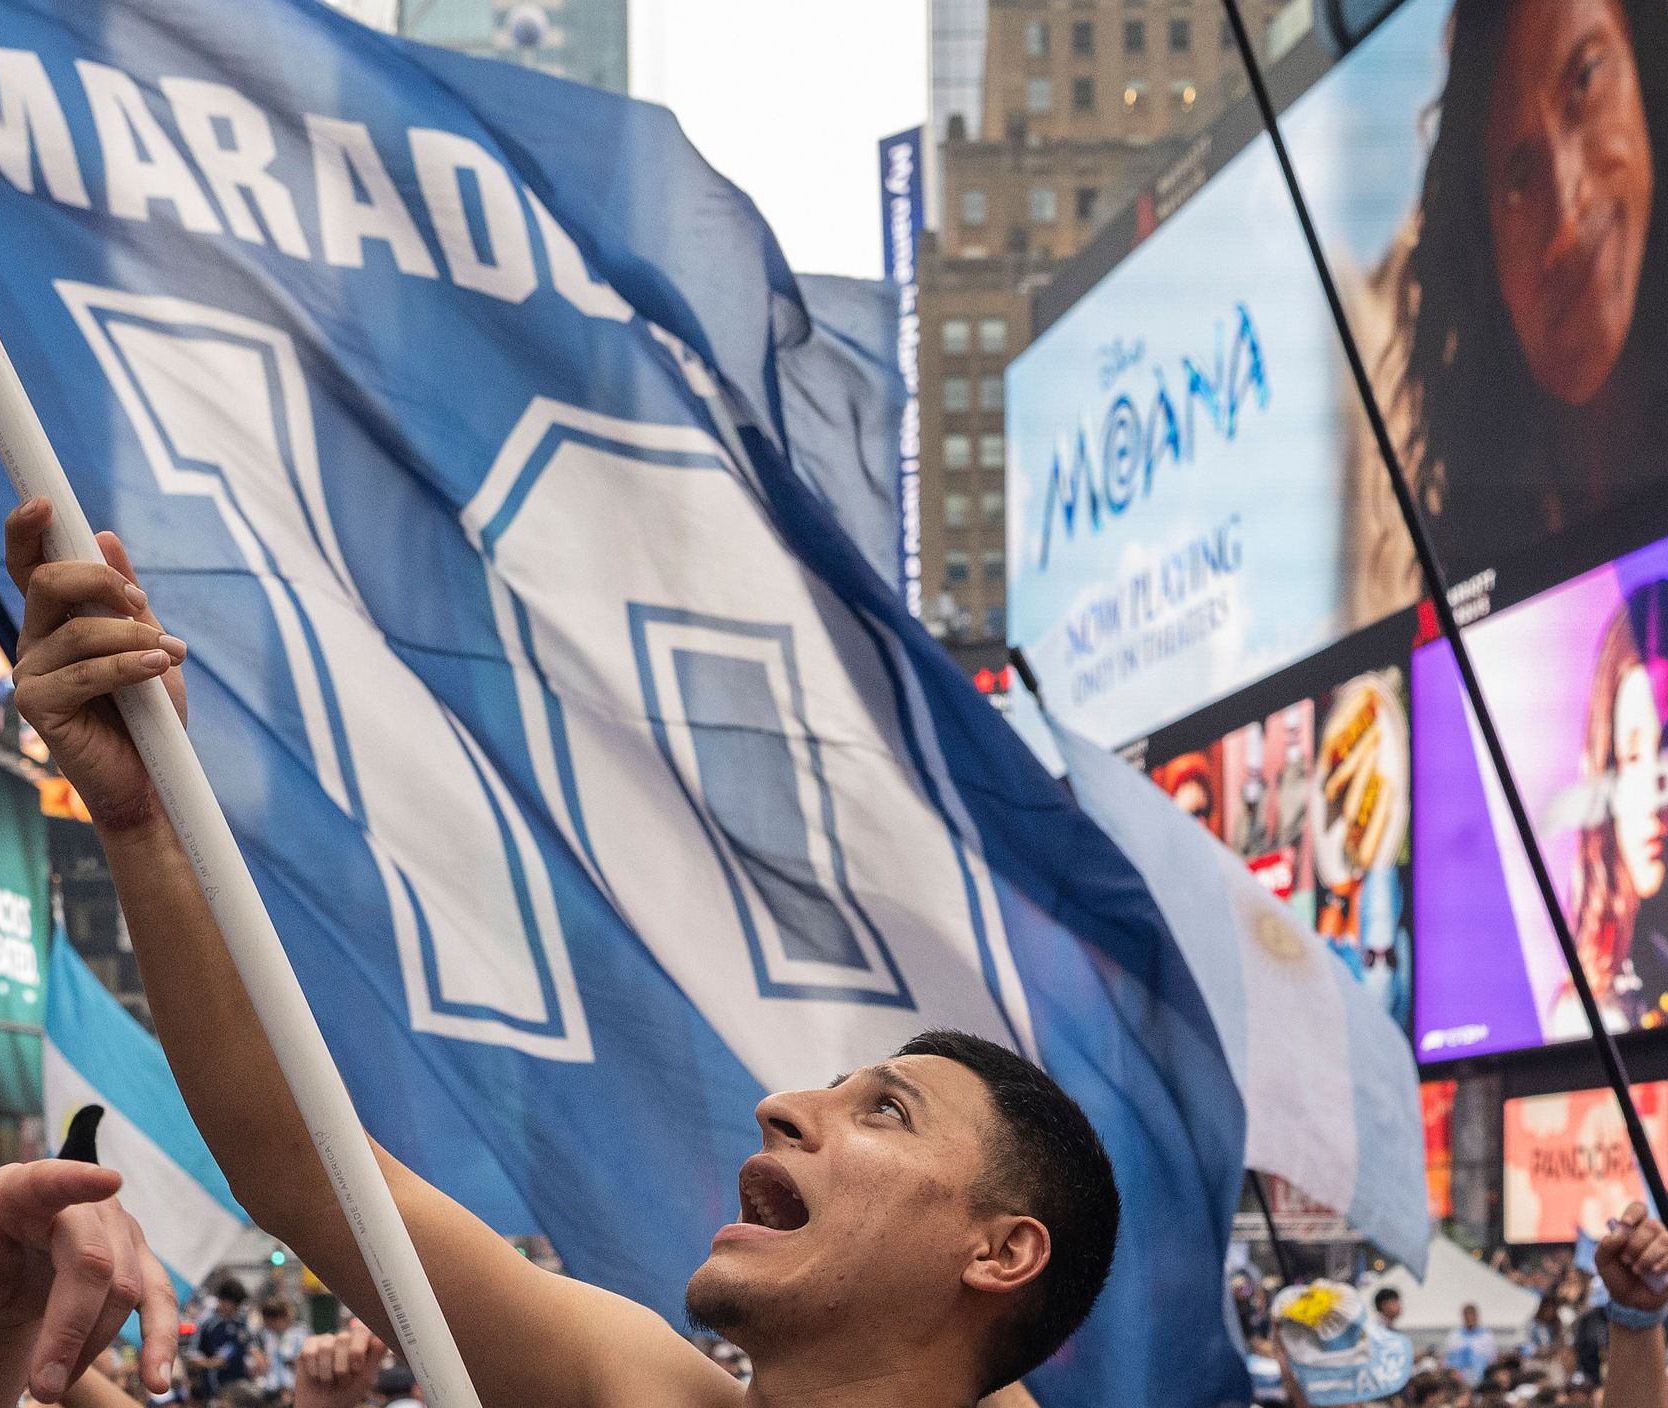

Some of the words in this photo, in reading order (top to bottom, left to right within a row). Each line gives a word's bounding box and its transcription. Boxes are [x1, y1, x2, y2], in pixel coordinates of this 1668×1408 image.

[1036, 300, 1274, 572] MOANA
[321, 1145, 346, 1192] AMERICA
[343, 1191, 354, 1204] IN
[348, 1204, 368, 1234] MADE
